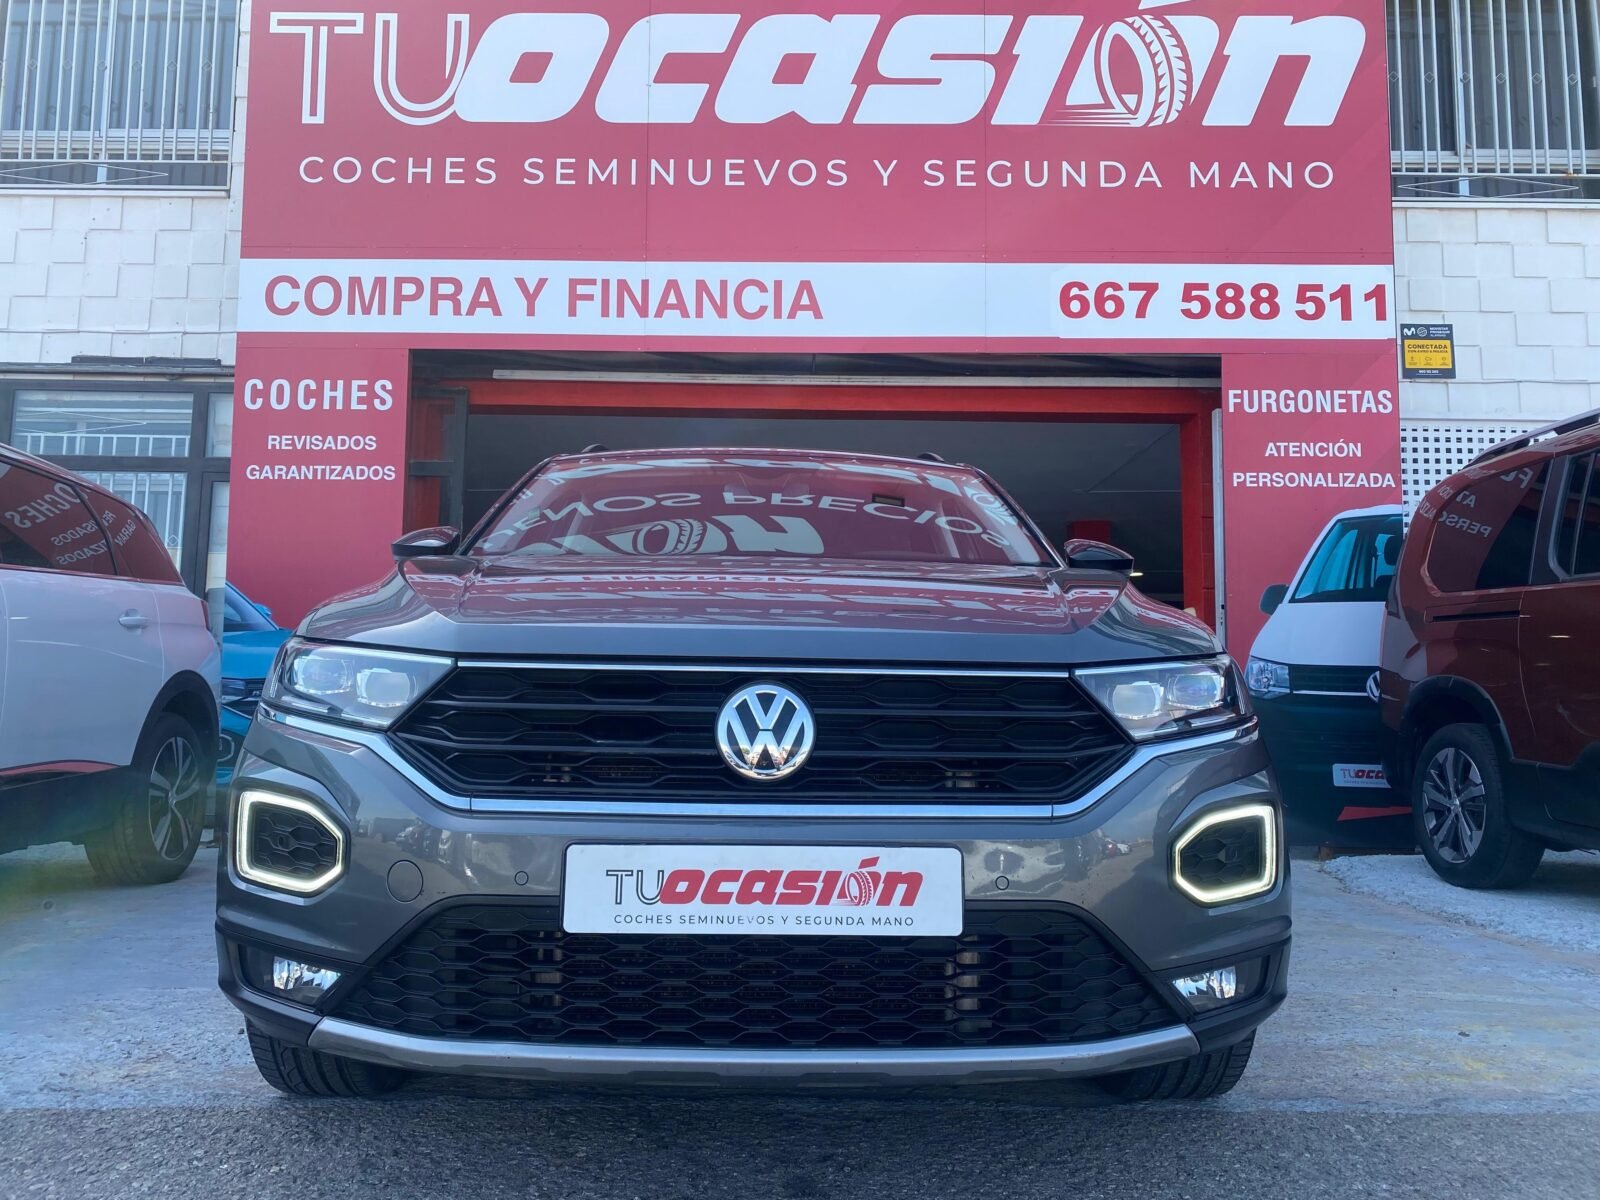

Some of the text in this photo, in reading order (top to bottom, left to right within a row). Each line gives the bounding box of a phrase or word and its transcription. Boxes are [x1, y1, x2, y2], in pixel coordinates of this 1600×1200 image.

[299, 156, 1334, 189] COCHES SEMINUEVOS Y SEGUNDA MANO
[264, 275, 824, 321] COMPRA Y FINANCIA
[1059, 281, 1387, 322] 667 588 511
[244, 378, 393, 411] COCHES
[1228, 389, 1393, 414] FURGONETAS
[267, 434, 377, 451] REVISADOS
[1264, 438, 1362, 458] ATENCIÓN
[245, 464, 396, 481] GARANTIZADOS
[1232, 471, 1396, 488] PERSONALIZADA
[614, 914, 914, 927] COCHES SEMINUEVOS Y SEGUNDA MANO
